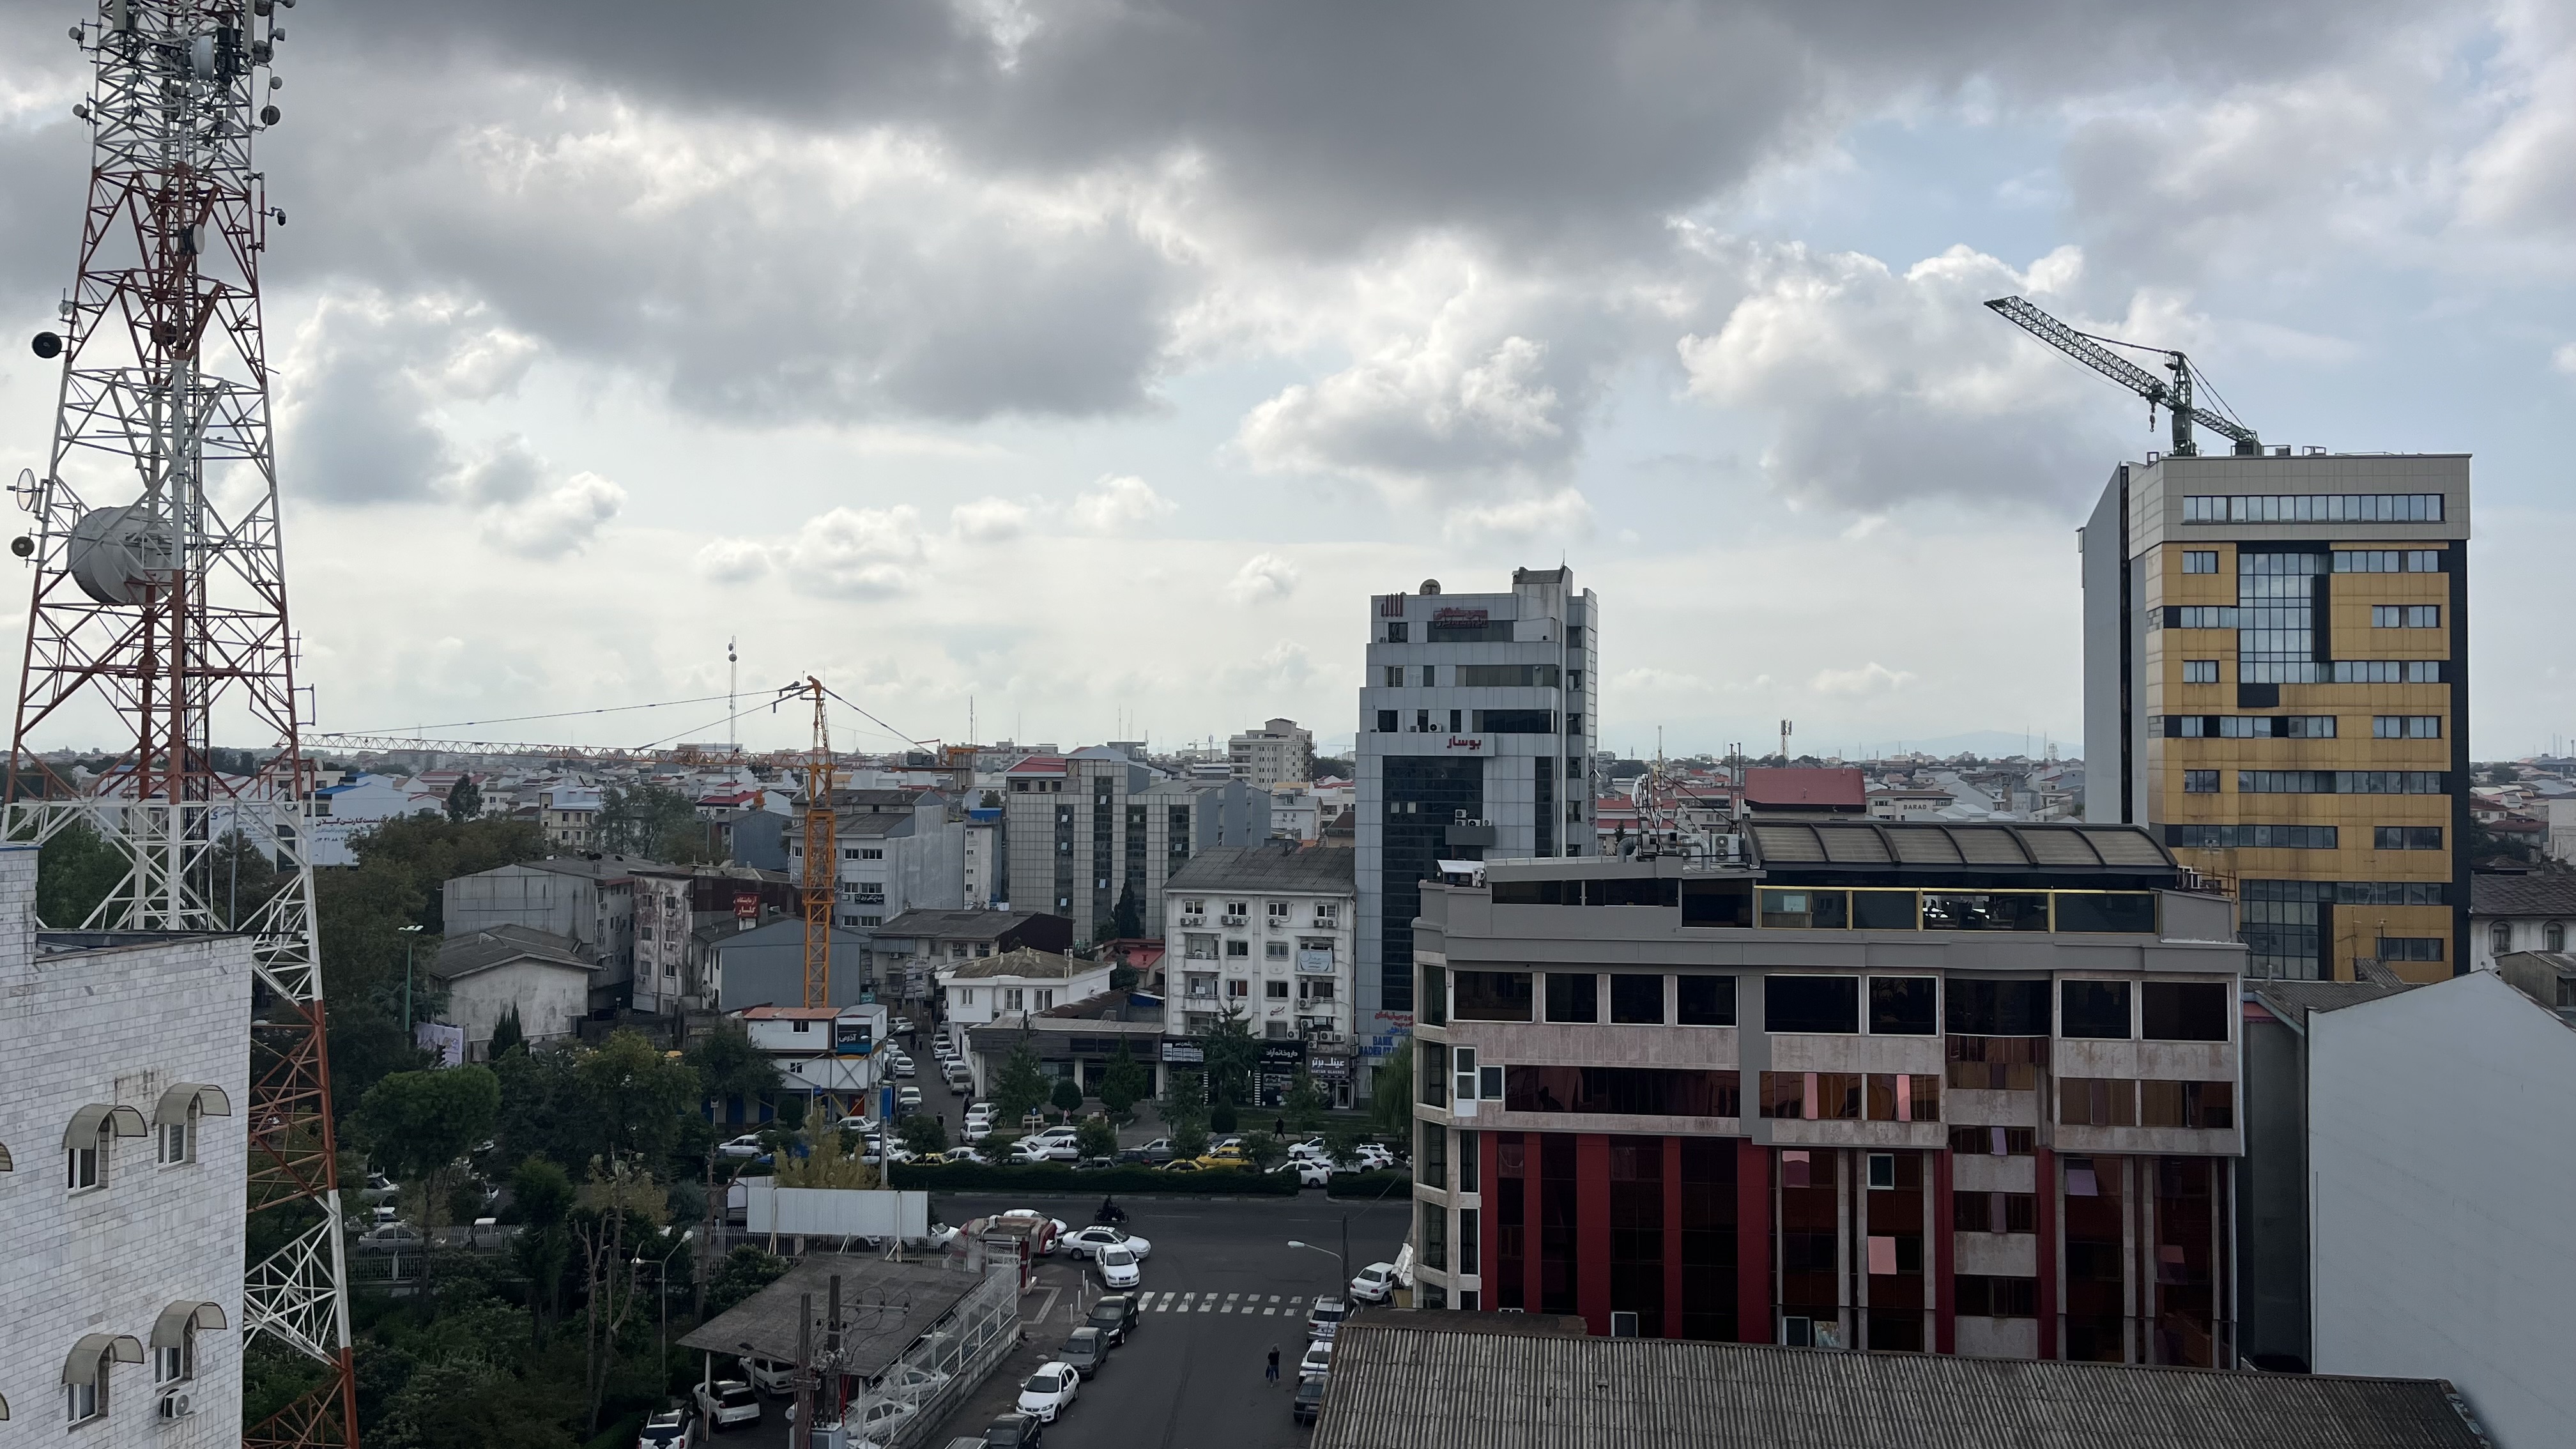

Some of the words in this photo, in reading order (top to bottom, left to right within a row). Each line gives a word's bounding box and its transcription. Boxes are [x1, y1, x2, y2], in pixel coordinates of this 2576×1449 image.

[1446, 735, 1482, 750] بوسار
[1373, 1036, 1393, 1046] BANK
[1275, 1049, 1298, 1058] داروخانه
[1312, 1057, 1324, 1068] برتر
[1324, 1057, 1345, 1068] عینک
